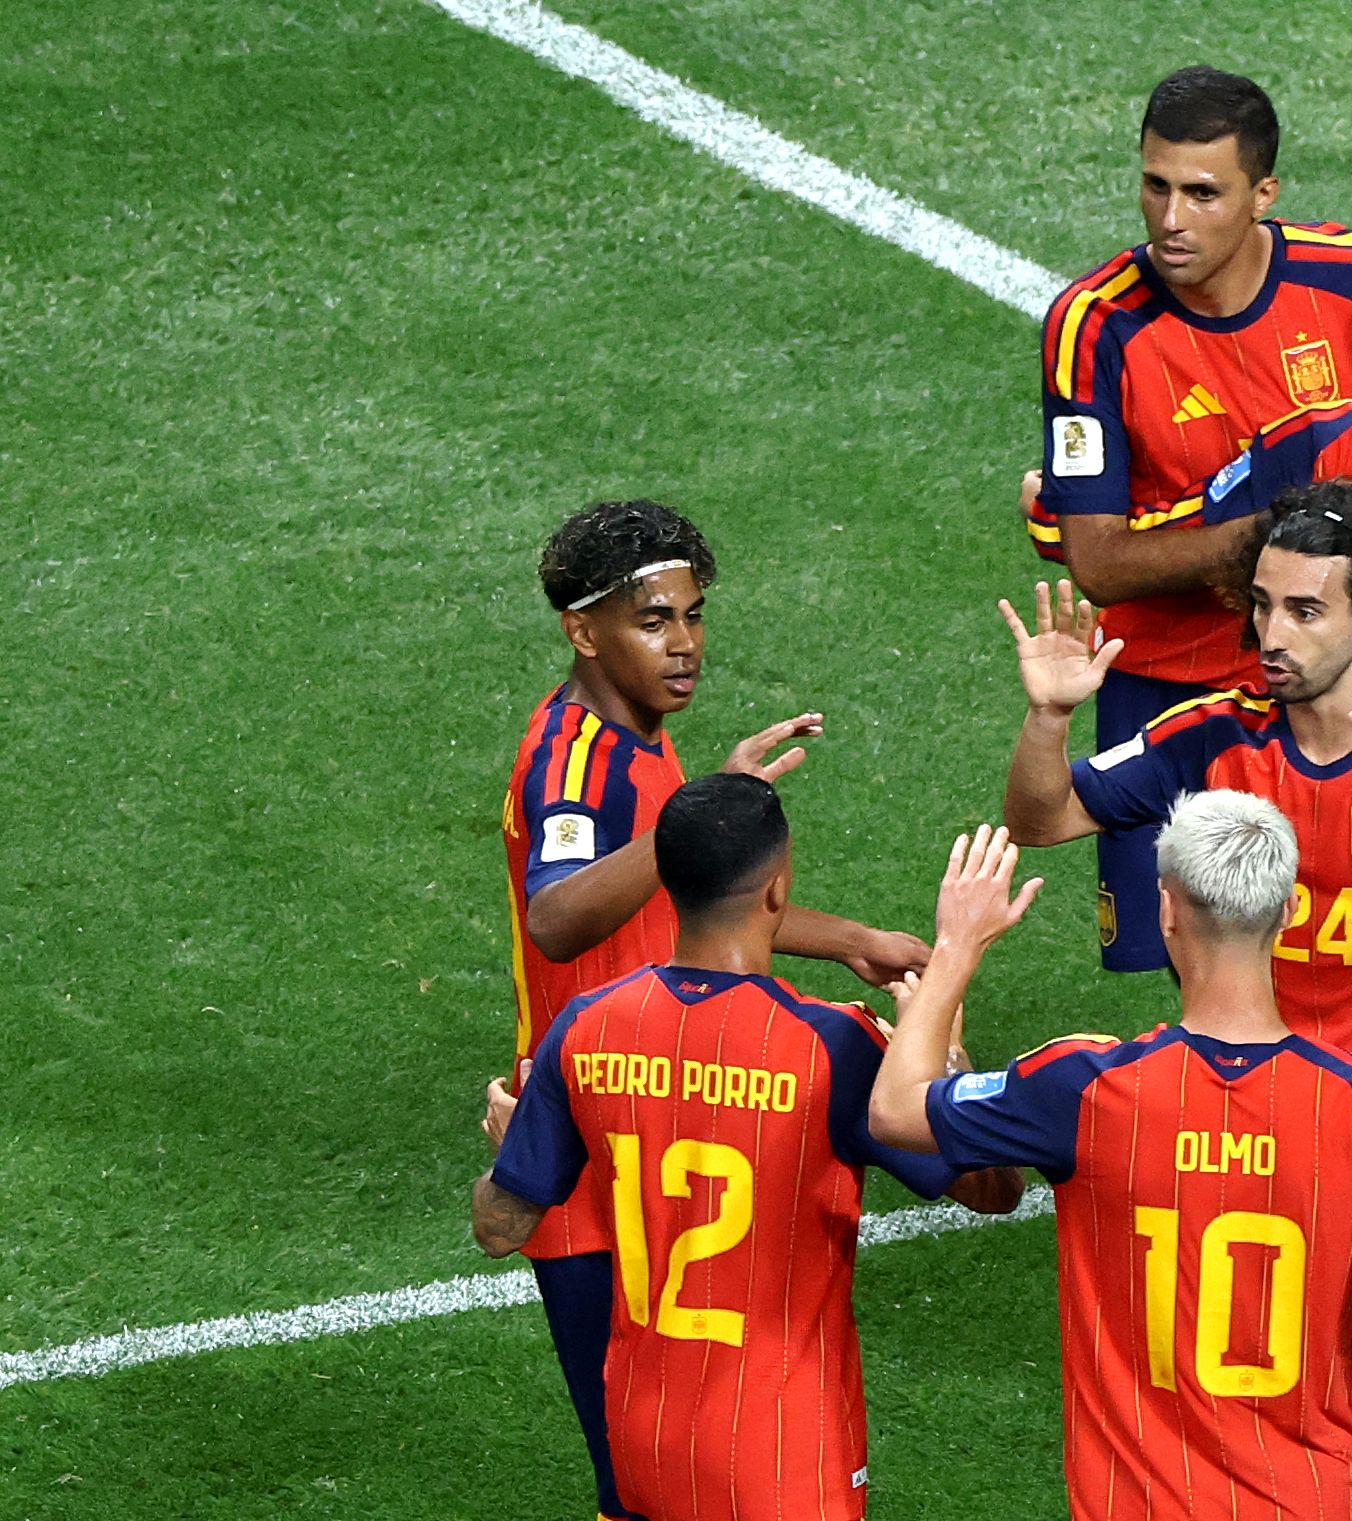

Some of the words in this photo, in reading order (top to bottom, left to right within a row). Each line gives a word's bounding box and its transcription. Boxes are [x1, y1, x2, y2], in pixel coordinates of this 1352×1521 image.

[572, 1052, 672, 1098] PEDRO
[682, 1059, 798, 1114] PORRO
[1174, 1130, 1277, 1177] OLMO
[606, 1132, 755, 1348] 12
[1134, 1205, 1307, 1398] 10
